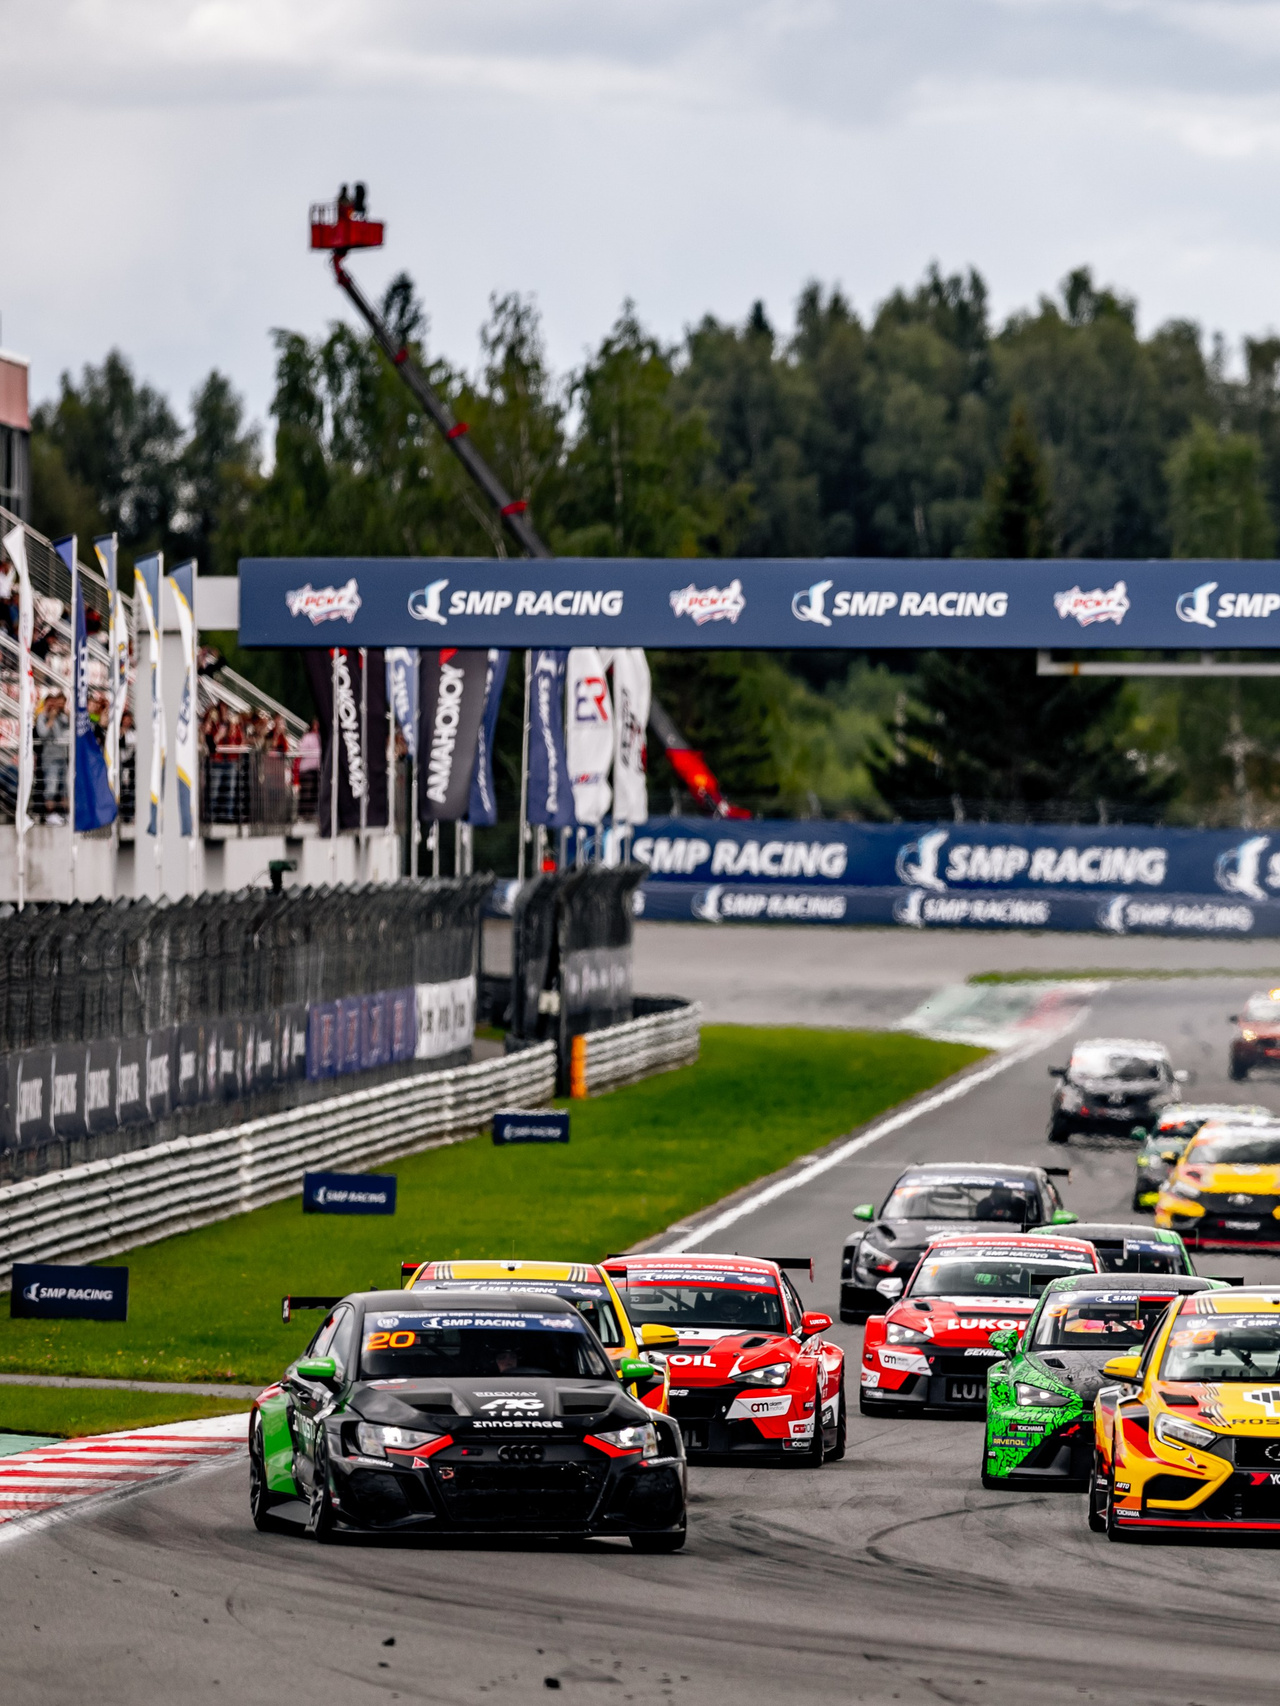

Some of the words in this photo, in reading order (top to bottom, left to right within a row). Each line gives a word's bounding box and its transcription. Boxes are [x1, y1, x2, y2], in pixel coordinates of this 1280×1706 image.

[449, 590, 512, 616] SMP
[514, 590, 623, 616] RACING
[832, 591, 897, 617] SMP
[899, 591, 1008, 617] RACING
[633, 837, 711, 874] SMP
[711, 839, 848, 878] RACING
[946, 845, 1029, 882] SMP
[1028, 846, 1168, 885] RACING
[721, 893, 768, 917] SMP
[767, 894, 847, 919] RACING
[924, 899, 970, 924] SMP
[969, 900, 1050, 925] RACING
[1008, 1251, 1049, 1259] RACING
[738, 1266, 770, 1274] TEAM
[39, 1287, 67, 1299] SMP
[66, 1288, 113, 1301] RACING
[442, 1318, 473, 1327] SMP
[474, 1319, 526, 1328] RACING
[947, 1318, 1029, 1330] LUKOI
[367, 1330, 416, 1350] 20
[1169, 1330, 1217, 1347] 28
[669, 1354, 717, 1367] OIL
[952, 1383, 988, 1399] LUK
[473, 1420, 564, 1428] INNOSTAGE
[1017, 1424, 1044, 1432] YOKOHAMA
[1117, 1509, 1140, 1517] YOKOHAMA
